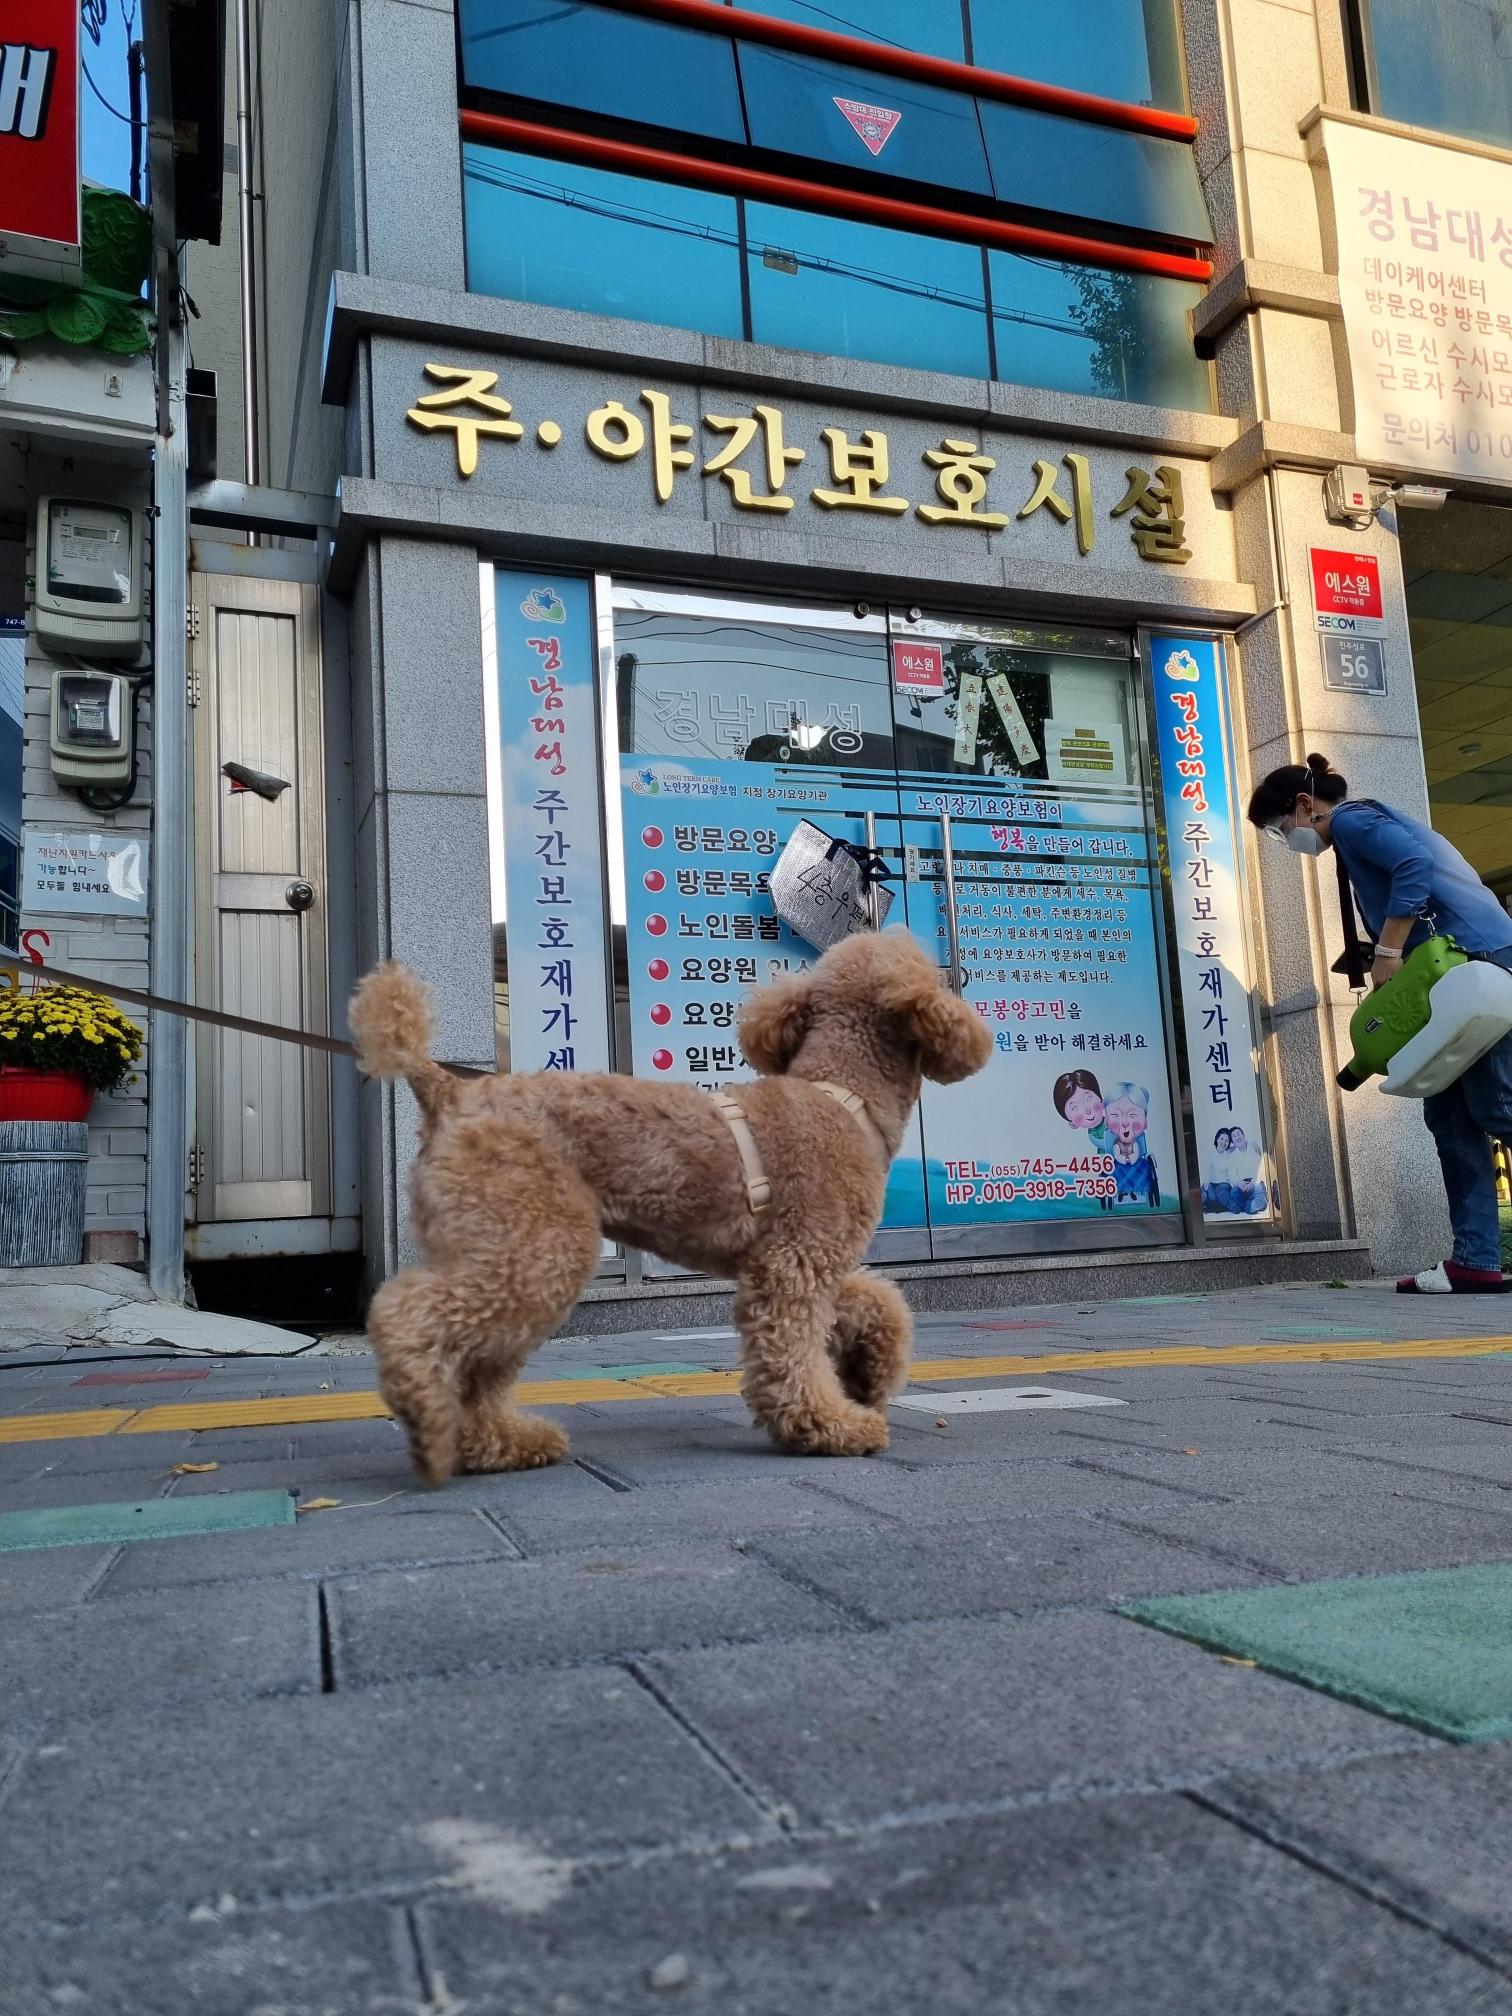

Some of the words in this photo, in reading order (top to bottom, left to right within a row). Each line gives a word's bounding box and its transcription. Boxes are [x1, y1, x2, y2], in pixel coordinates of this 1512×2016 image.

[1363, 257, 1486, 304] 데이케어센터
[1364, 289, 1448, 327] 방문요양
[1454, 305, 1512, 340] 방문목
[1371, 328, 1439, 366] 어르신
[1446, 341, 1512, 375] 수시모
[1376, 362, 1444, 400] 근로자
[1381, 412, 1457, 456] 문의처
[1325, 571, 1371, 597] 에스원
[1317, 615, 1356, 631] SECOM
[1339, 641, 1367, 652] 진주성로
[902, 655, 934, 672] 에스원
[1340, 653, 1369, 679] 56
[526, 636, 567, 776] 경남대성
[961, 683, 977, 755] 立春大吉
[654, 689, 864, 754] 경남대성
[1171, 692, 1207, 812] 경남대성
[663, 781, 737, 797] 노인장기요양보험
[742, 786, 763, 798] 지정
[767, 787, 828, 801] 장기요양기관
[683, 775, 702, 783] TERM
[702, 776, 720, 784] CARE
[917, 795, 1063, 821] 노인장기요양보험이
[674, 826, 777, 855] 방문요양
[991, 825, 1040, 852] 행복을
[1043, 835, 1084, 855] 만들어
[1088, 839, 1134, 857] 갑니다.
[968, 862, 990, 877] 치매
[1001, 863, 1023, 878] 중풍
[1035, 865, 1067, 879] 파킨슨
[1070, 865, 1080, 879] 등
[1083, 865, 1114, 881] 노인성
[1117, 867, 1137, 881] 질병
[37, 880, 65, 892] 모두들
[72, 882, 110, 894] 힘내세요
[969, 883, 1001, 897] 거동이
[1006, 885, 1037, 898] 불편한
[1041, 886, 1073, 900] 분에게
[678, 914, 781, 940] 노인돌봄
[1051, 907, 1113, 922] 주변환경정리
[1116, 909, 1127, 922] 등
[1006, 927, 1049, 941] 필요하게
[1053, 928, 1085, 942] 되었을
[1088, 930, 1097, 942] 때
[1101, 929, 1132, 942] 본인의
[982, 948, 1047, 963] 요양보호사가
[1051, 949, 1093, 963] 방문하여
[1097, 950, 1127, 963] 필요한
[680, 957, 757, 984] 요양원
[1011, 969, 1053, 983] 제공하는
[1057, 970, 1114, 984] 제도입니다.
[683, 1001, 746, 1028] 요양
[1034, 1032, 1067, 1051] 받아
[1071, 1033, 1149, 1051] 해결하세요
[946, 1178, 1117, 1203] HP.010-3918-7356
